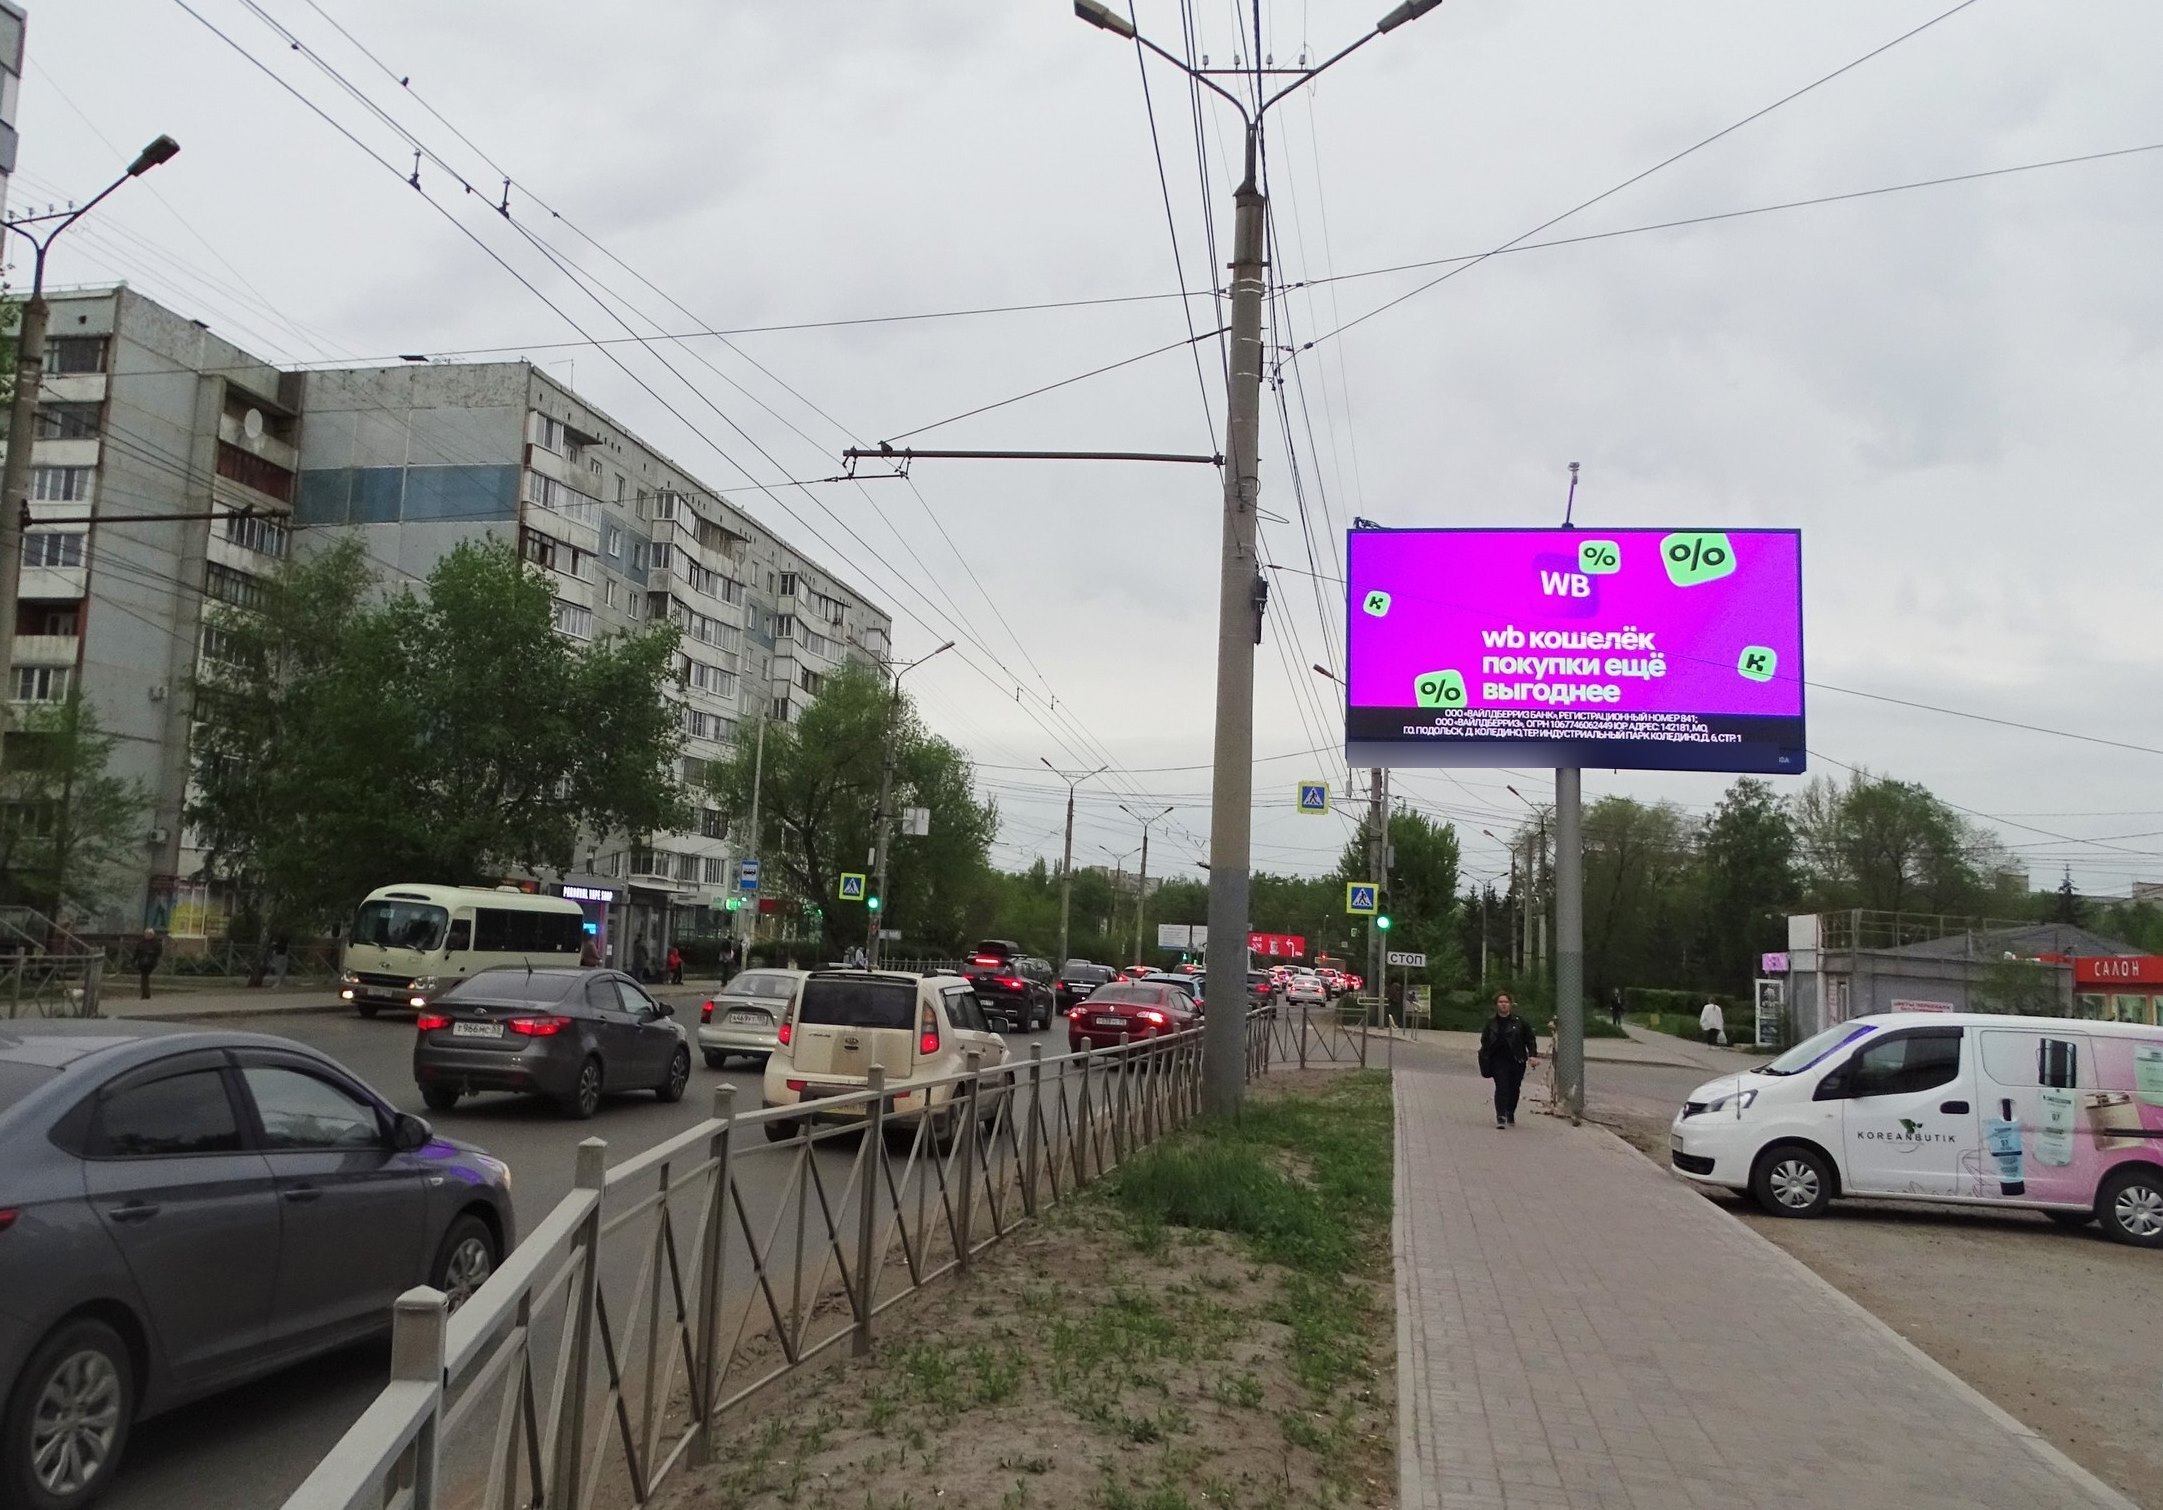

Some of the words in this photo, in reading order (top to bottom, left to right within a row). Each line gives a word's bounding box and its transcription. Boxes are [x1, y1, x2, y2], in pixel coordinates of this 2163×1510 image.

[1540, 570, 1591, 598] WB
[1481, 625, 1525, 649] wb
[1529, 625, 1656, 650] кошелёк
[1483, 656, 1600, 681] покупки
[1604, 652, 1667, 681] ещё
[1483, 682, 1621, 705] выгоднее
[1444, 709, 1463, 717] ООО
[1559, 711, 1648, 721] РЕГИСТРАЦИОННЫЙ
[1648, 713, 1680, 722] НОМЕР
[1435, 718, 1454, 726] ООО
[1526, 719, 1549, 728] ОГРН
[1540, 730, 1625, 740] ИНДУСТРИАЛЬНЫЙ
[1626, 731, 1650, 740] ПАРК
[1390, 953, 1423, 965] СТОП
[2094, 961, 2140, 976] САЛОН
[1857, 1131, 1956, 1143] KOREANBUTIK
